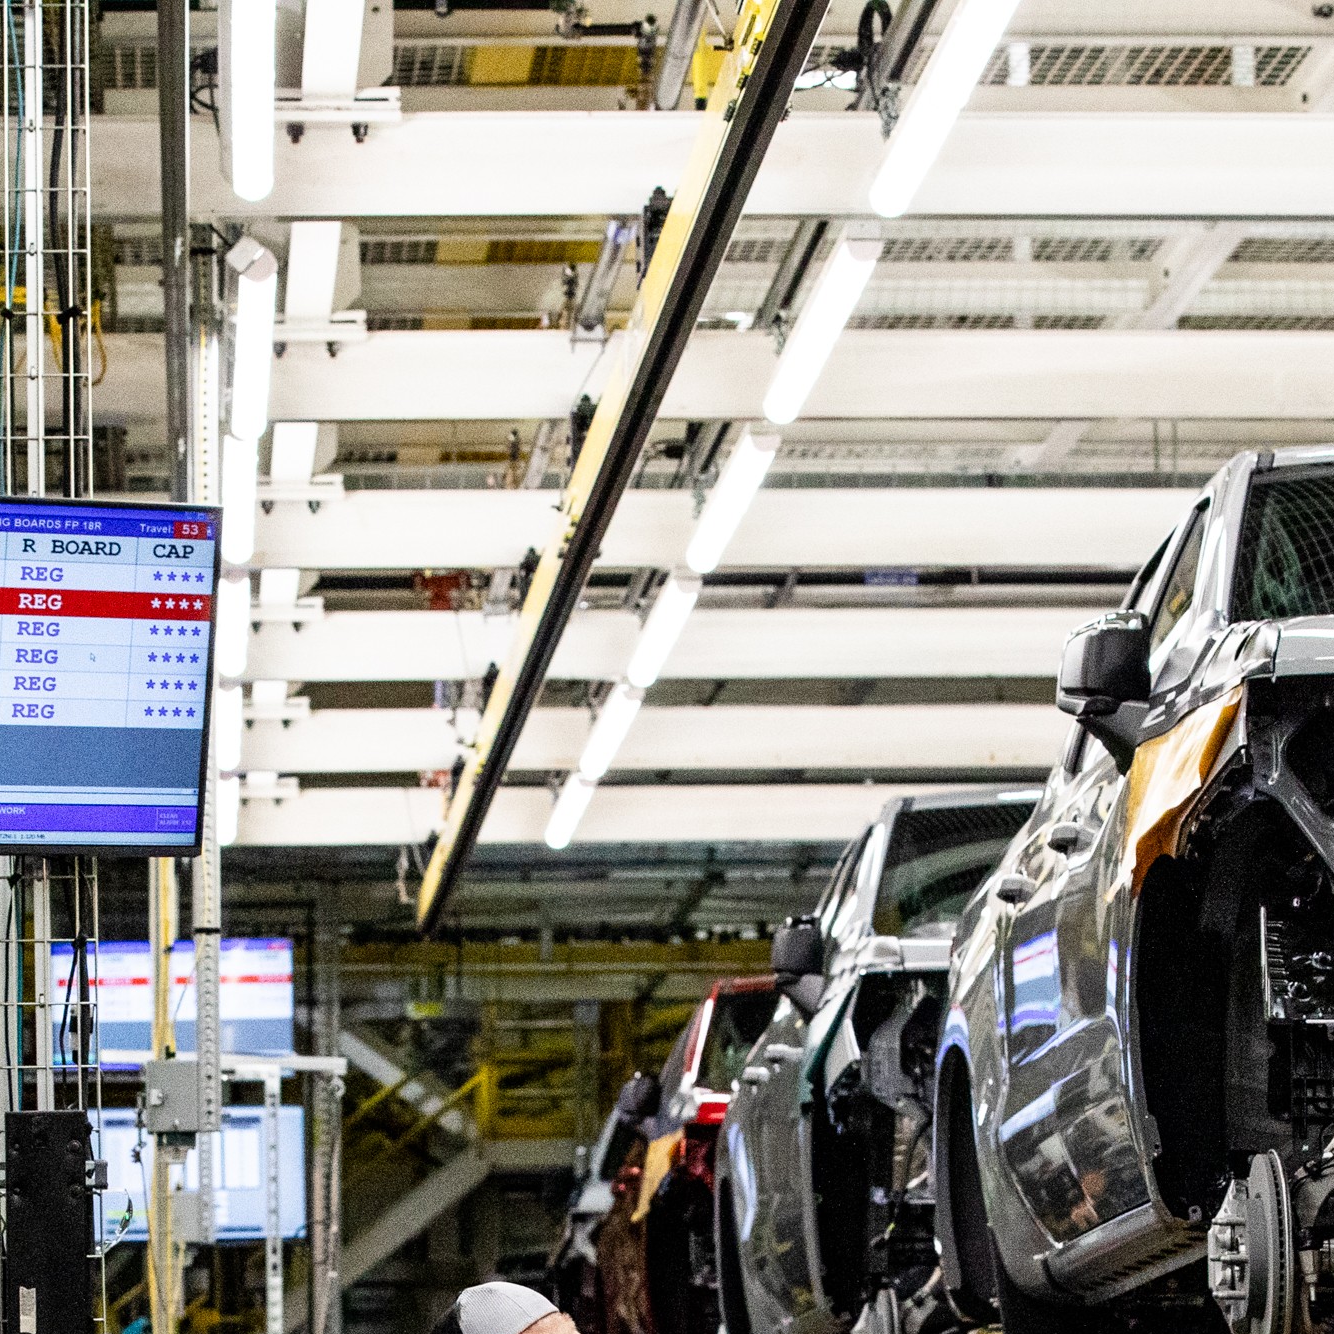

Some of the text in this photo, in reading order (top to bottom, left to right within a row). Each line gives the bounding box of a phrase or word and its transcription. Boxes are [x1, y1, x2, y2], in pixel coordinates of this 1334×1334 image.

[14, 518, 61, 529] BOARDS
[65, 521, 79, 530] FP
[83, 521, 102, 530] 18R
[182, 525, 199, 535] 53
[23, 539, 36, 552] R
[52, 540, 121, 556] BOARD
[153, 545, 194, 559] CAP
[20, 567, 63, 582] REG
[19, 594, 62, 611] REG
[17, 621, 60, 638] REG
[15, 649, 59, 665] REG
[13, 676, 56, 692] REG
[12, 703, 55, 719] REG
